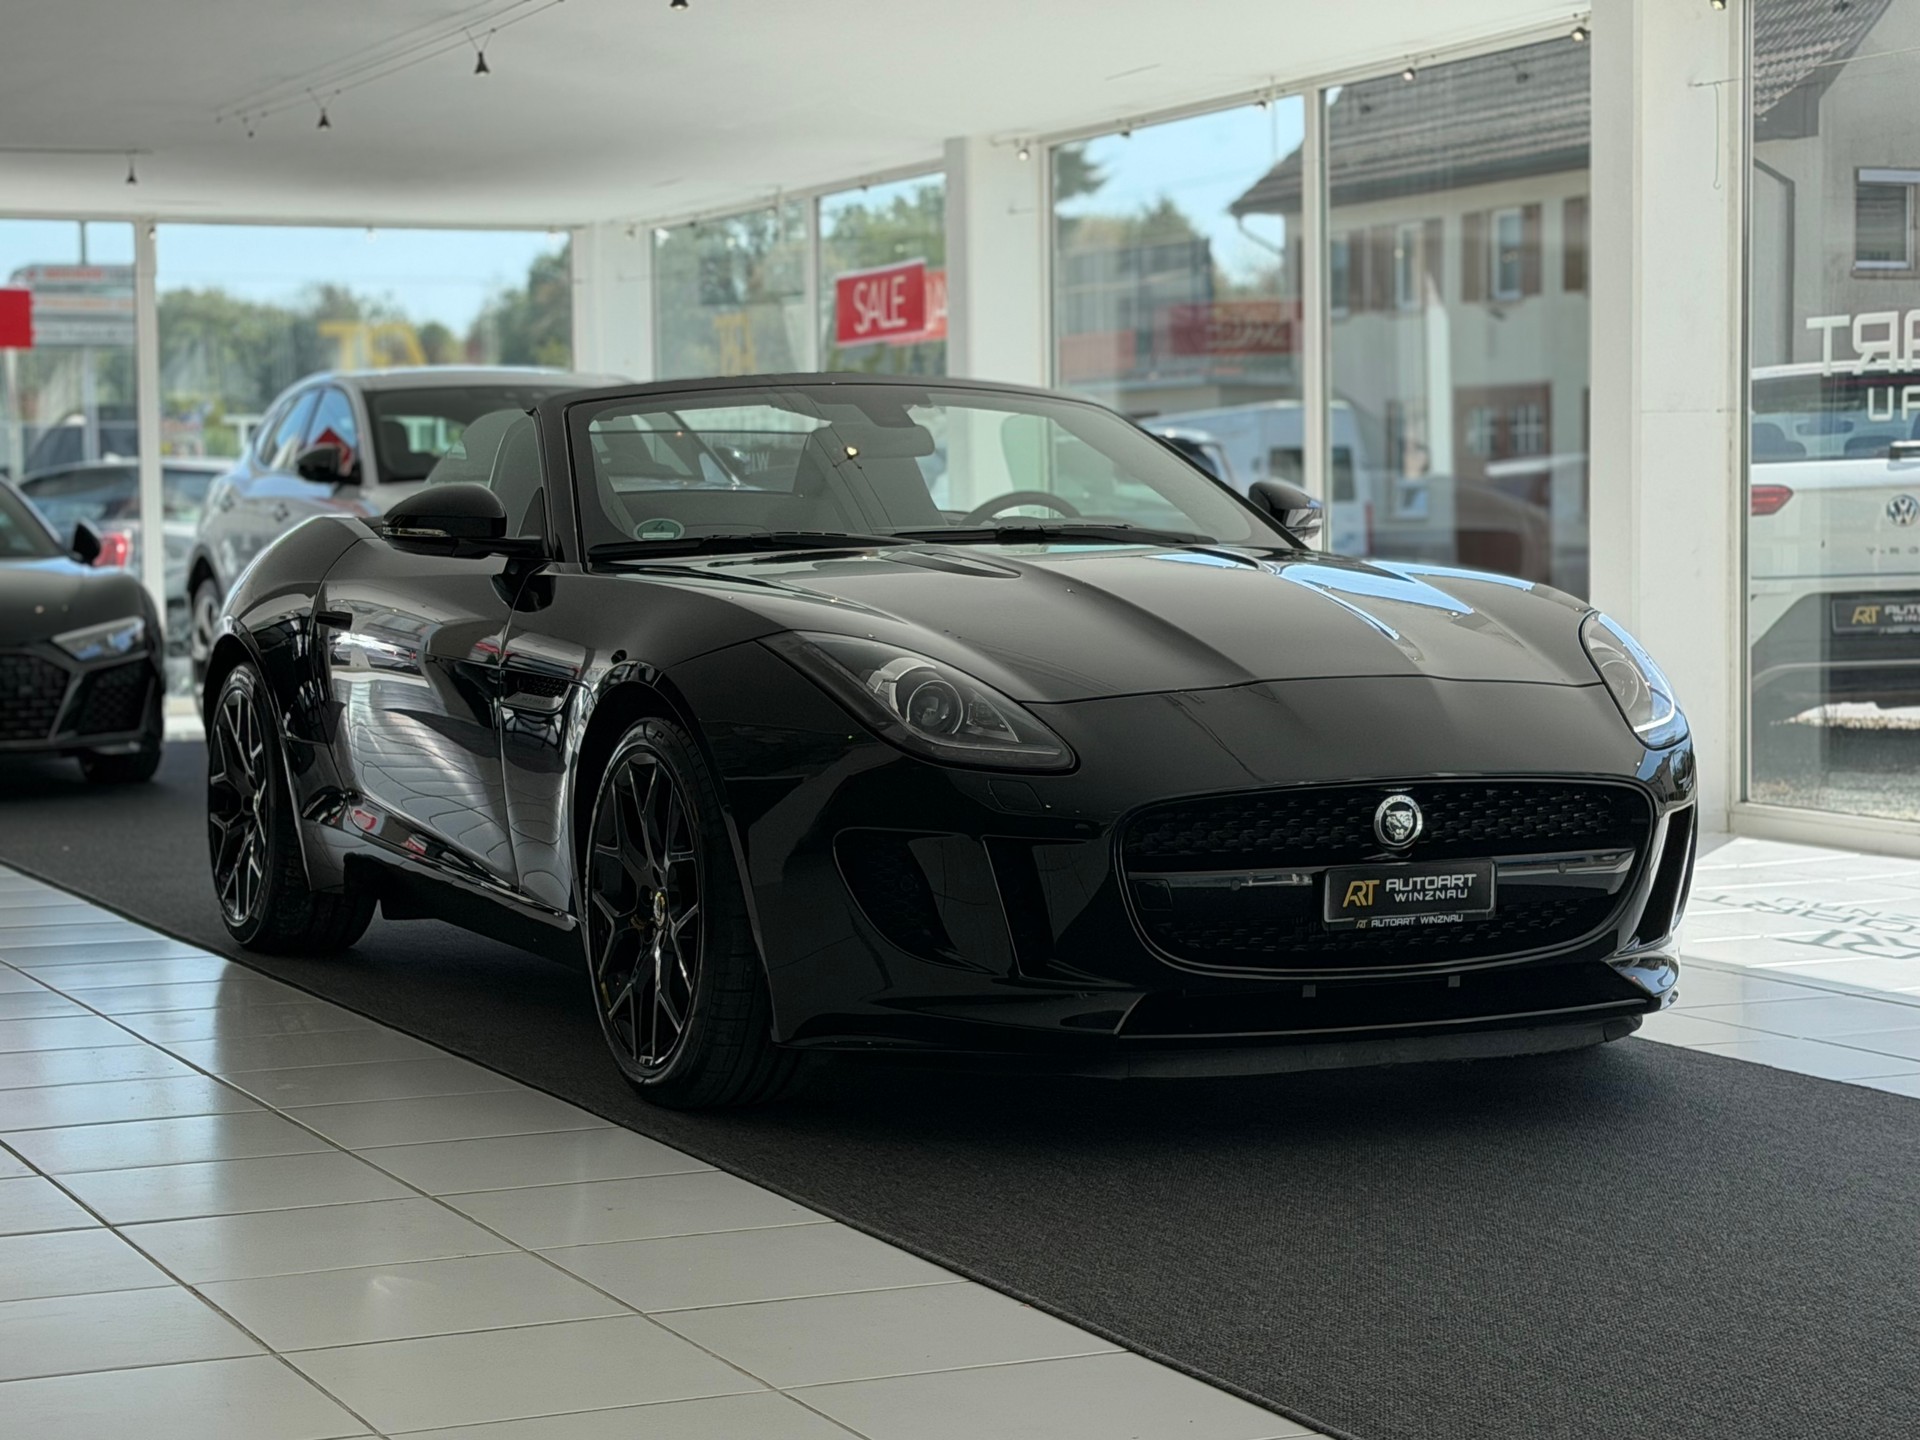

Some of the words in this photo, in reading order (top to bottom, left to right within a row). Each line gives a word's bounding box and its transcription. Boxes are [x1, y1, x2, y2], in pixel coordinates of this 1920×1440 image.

[852, 275, 908, 335] SALE
[1385, 873, 1477, 893] AUTOART
[1394, 888, 1468, 903] WINZNAU
[1371, 917, 1416, 928] AUTOART
[1420, 914, 1464, 925] WINZNAU
